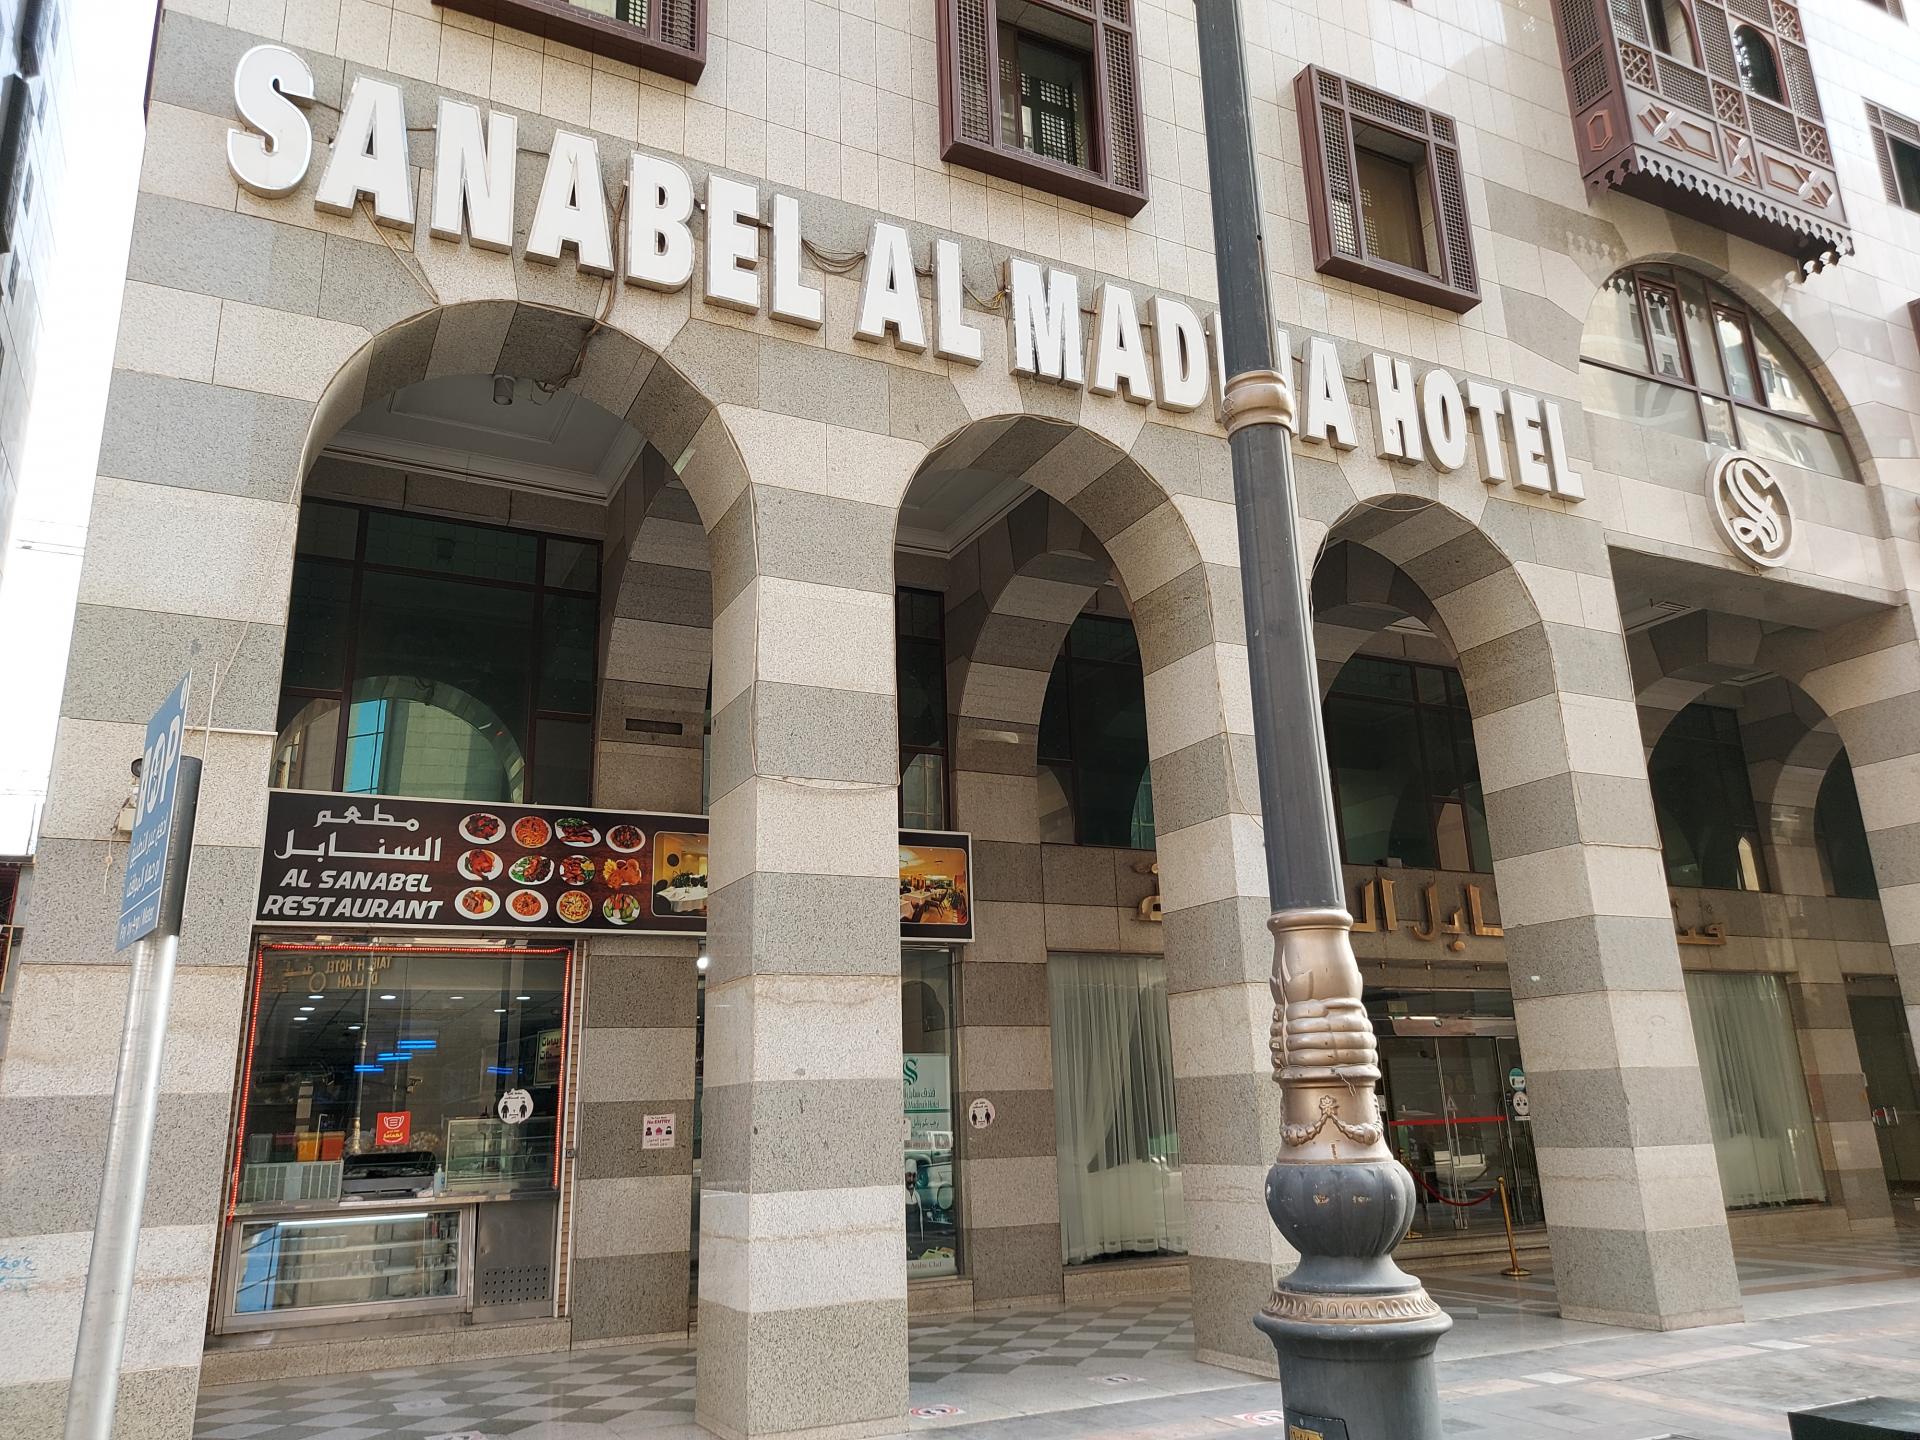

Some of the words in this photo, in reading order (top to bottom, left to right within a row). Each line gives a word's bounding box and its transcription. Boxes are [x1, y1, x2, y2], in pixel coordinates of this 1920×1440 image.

[227, 44, 825, 331] SANABEL
[852, 219, 983, 367] AL
[1009, 256, 1358, 450] MADA
[1364, 351, 1587, 502] HOTEL
[312, 803, 420, 831] مطعم
[273, 828, 442, 863] السنابل
[280, 868, 312, 888] AL
[318, 870, 433, 893] SANABEL
[262, 894, 444, 920] RESTAURANT
